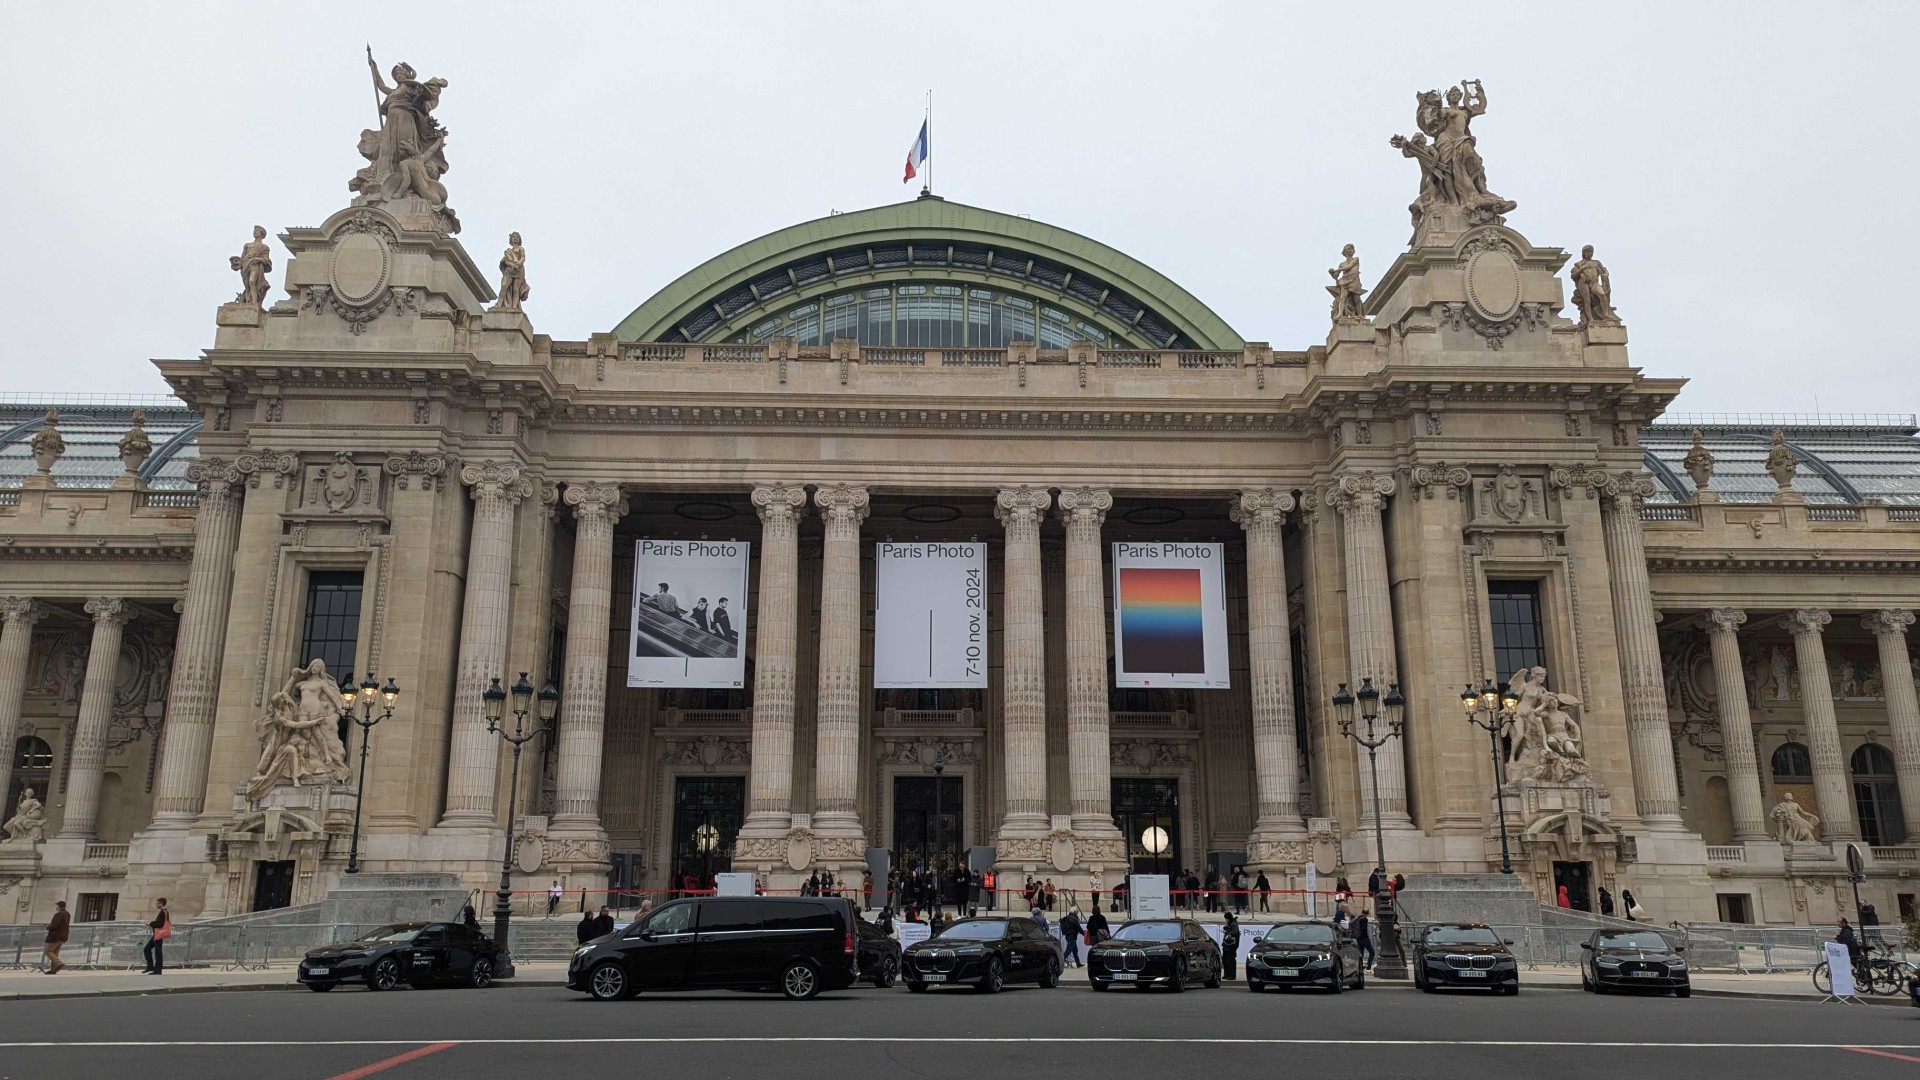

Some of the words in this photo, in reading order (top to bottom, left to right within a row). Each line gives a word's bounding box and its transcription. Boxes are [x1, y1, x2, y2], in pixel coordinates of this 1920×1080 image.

[642, 541, 683, 556] Paris
[688, 542, 737, 557] Photo
[882, 544, 922, 558] Paris
[927, 544, 975, 558] Photo
[1118, 543, 1158, 558] Paris
[1163, 544, 1211, 559] Photo
[966, 567, 981, 608] 2024
[969, 612, 981, 642] nov.
[966, 646, 981, 677] 7-10
